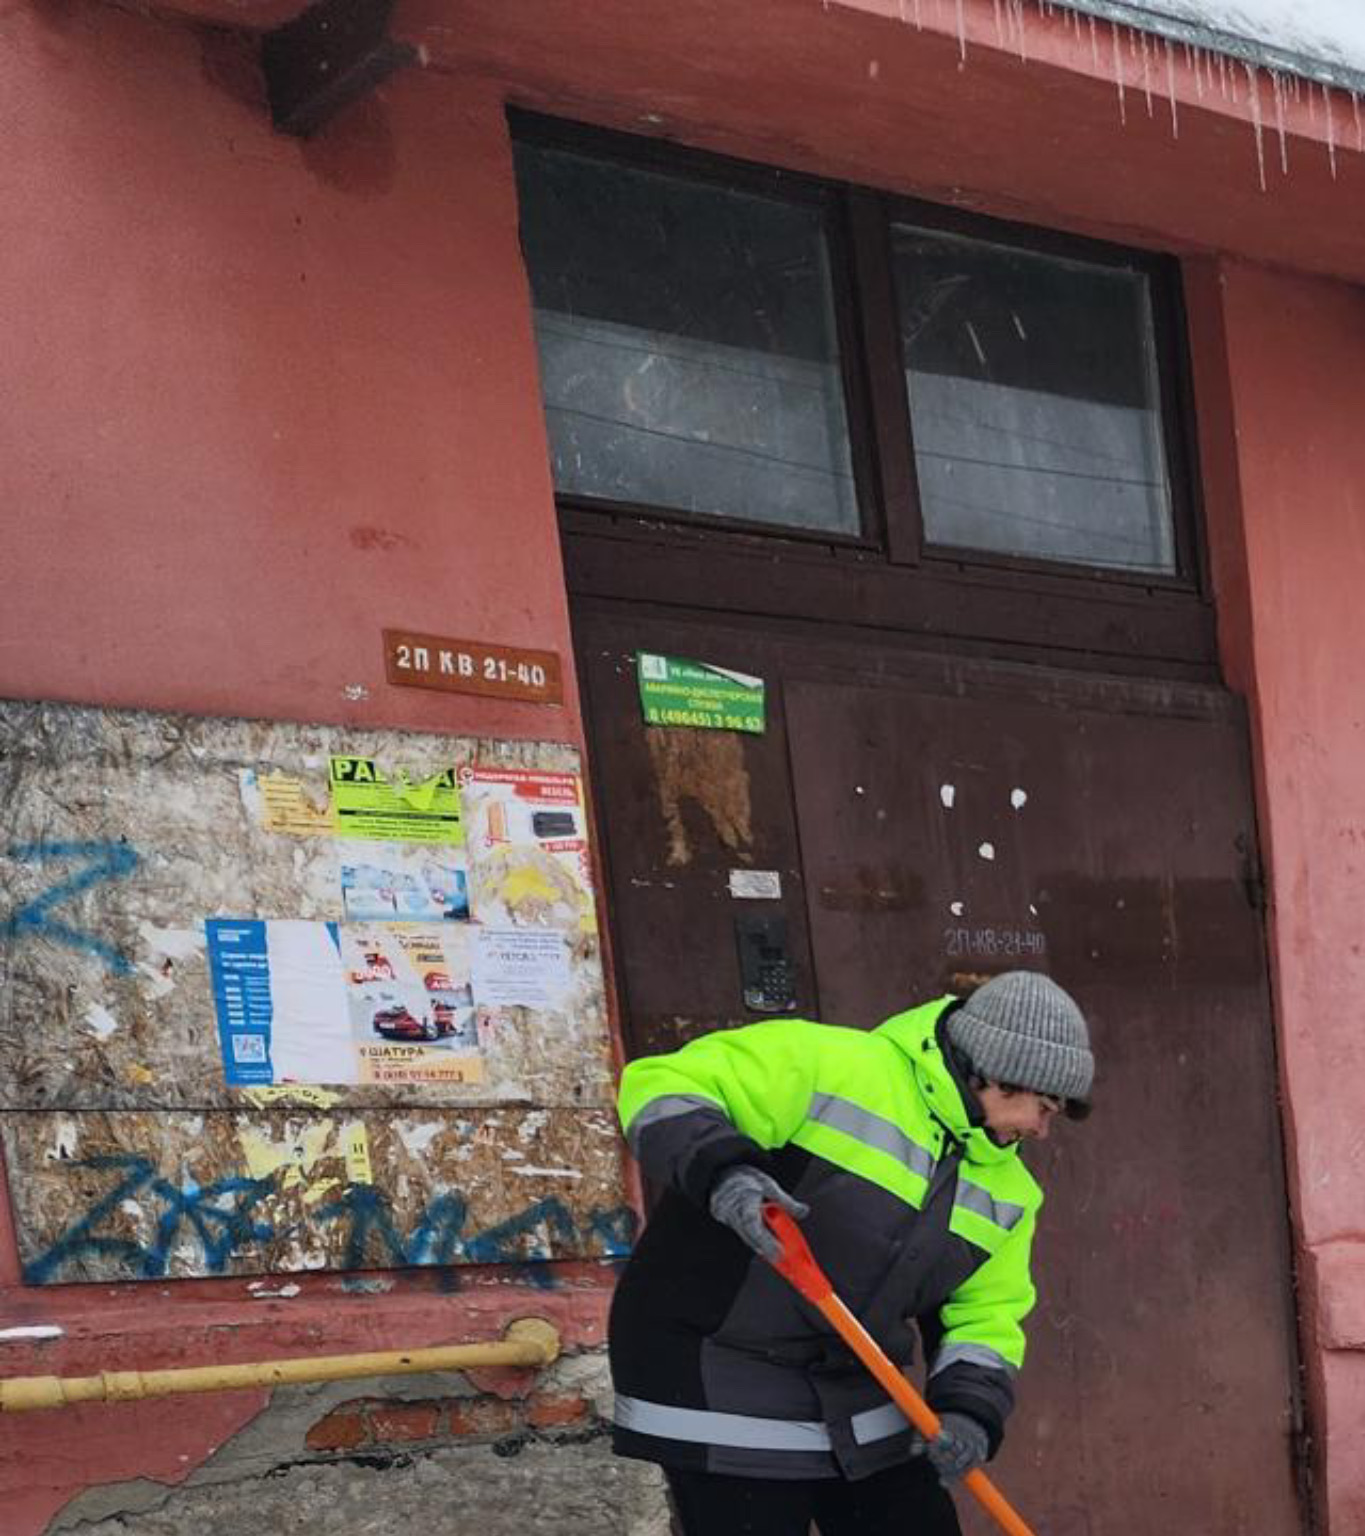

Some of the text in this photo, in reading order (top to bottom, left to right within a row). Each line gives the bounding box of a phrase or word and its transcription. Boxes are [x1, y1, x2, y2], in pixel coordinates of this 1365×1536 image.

[397, 645, 546, 688] 2П КВ 21-40
[369, 1047, 424, 1057] ШАТУРА
